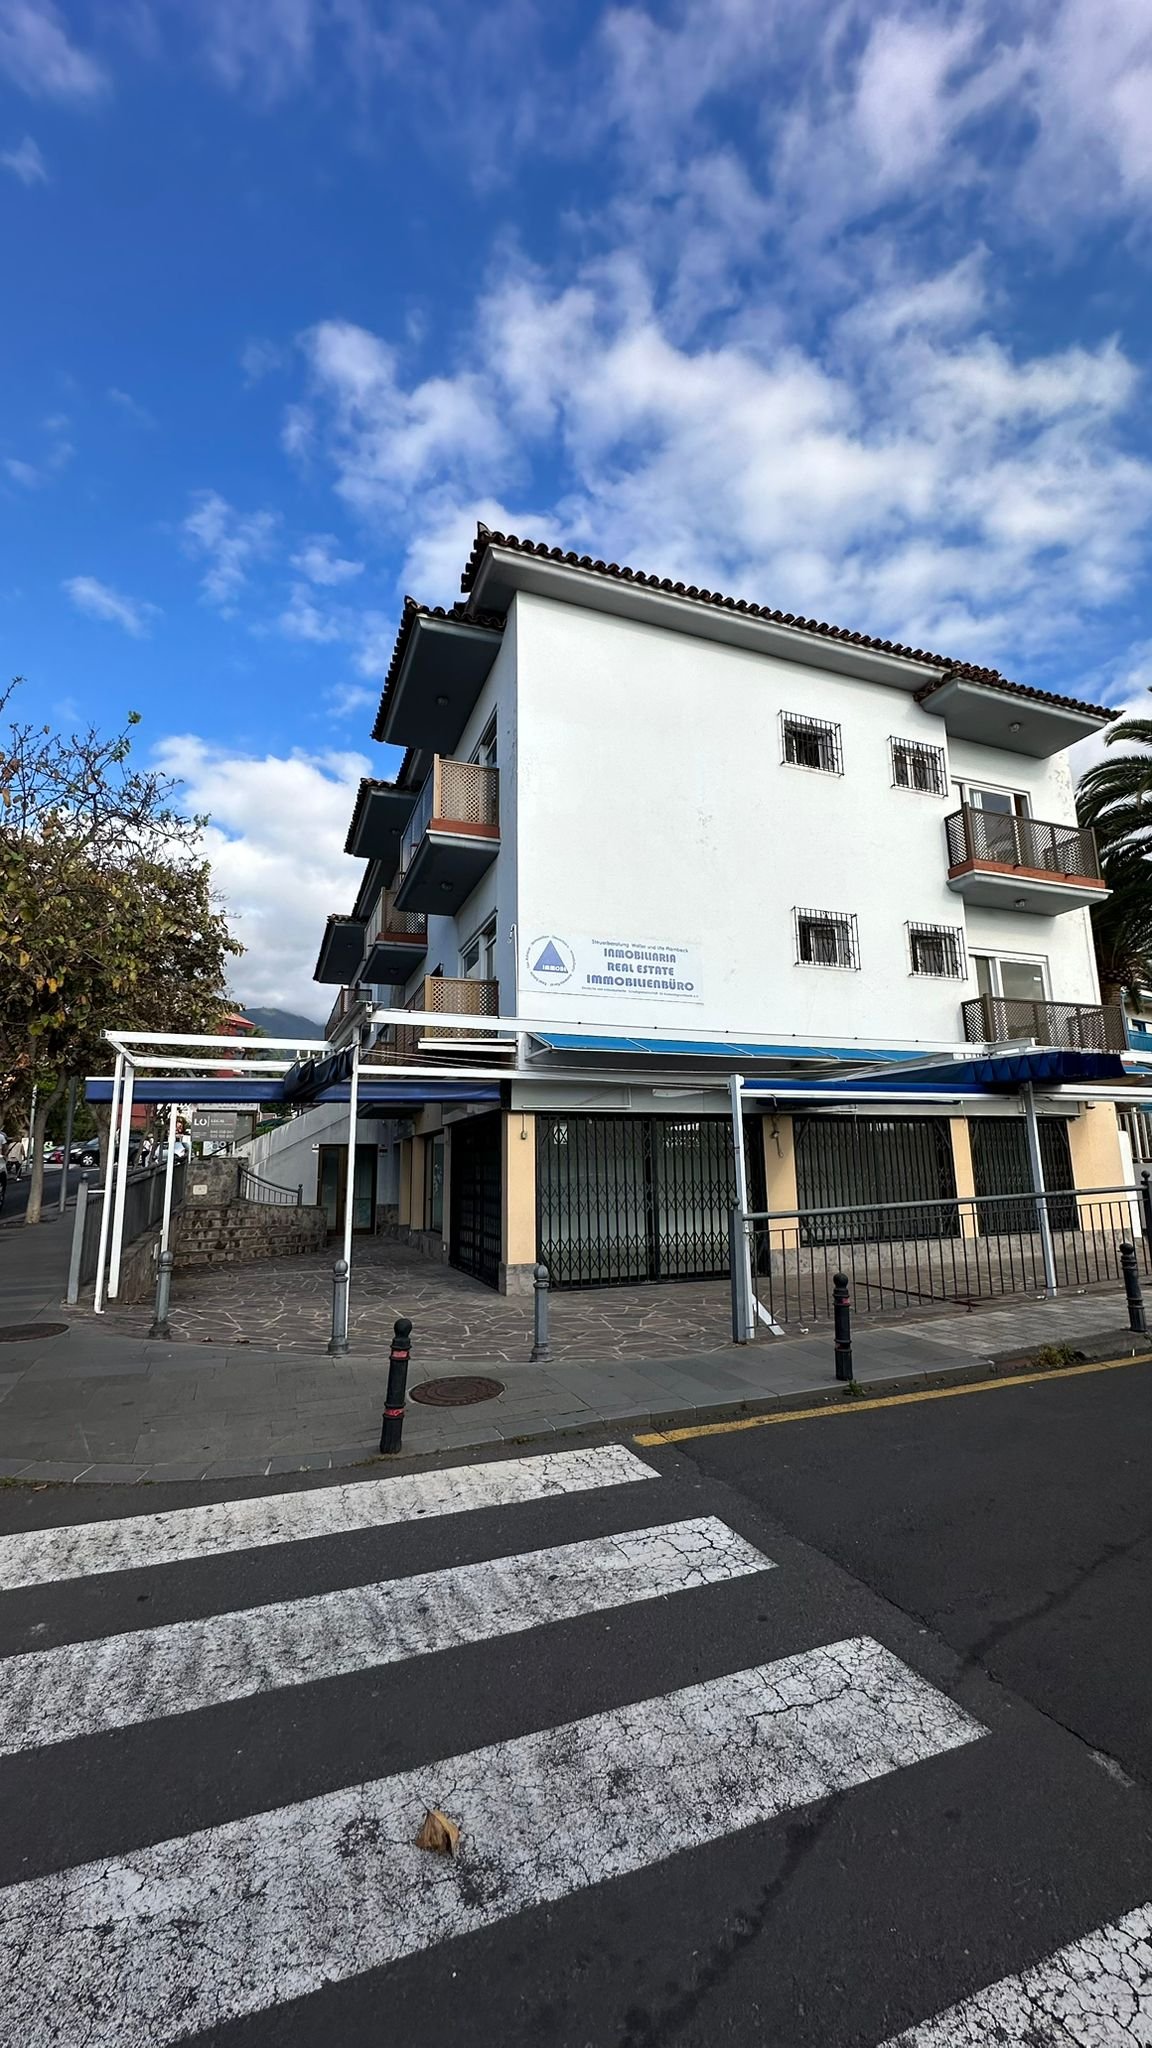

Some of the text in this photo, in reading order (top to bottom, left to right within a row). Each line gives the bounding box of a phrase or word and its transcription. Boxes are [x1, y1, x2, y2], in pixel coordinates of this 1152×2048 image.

[604, 948, 676, 963] INMOBILIARIA
[607, 962, 674, 976] REAL ESTATE
[587, 974, 694, 991] IMMOBILIENBÜRO
